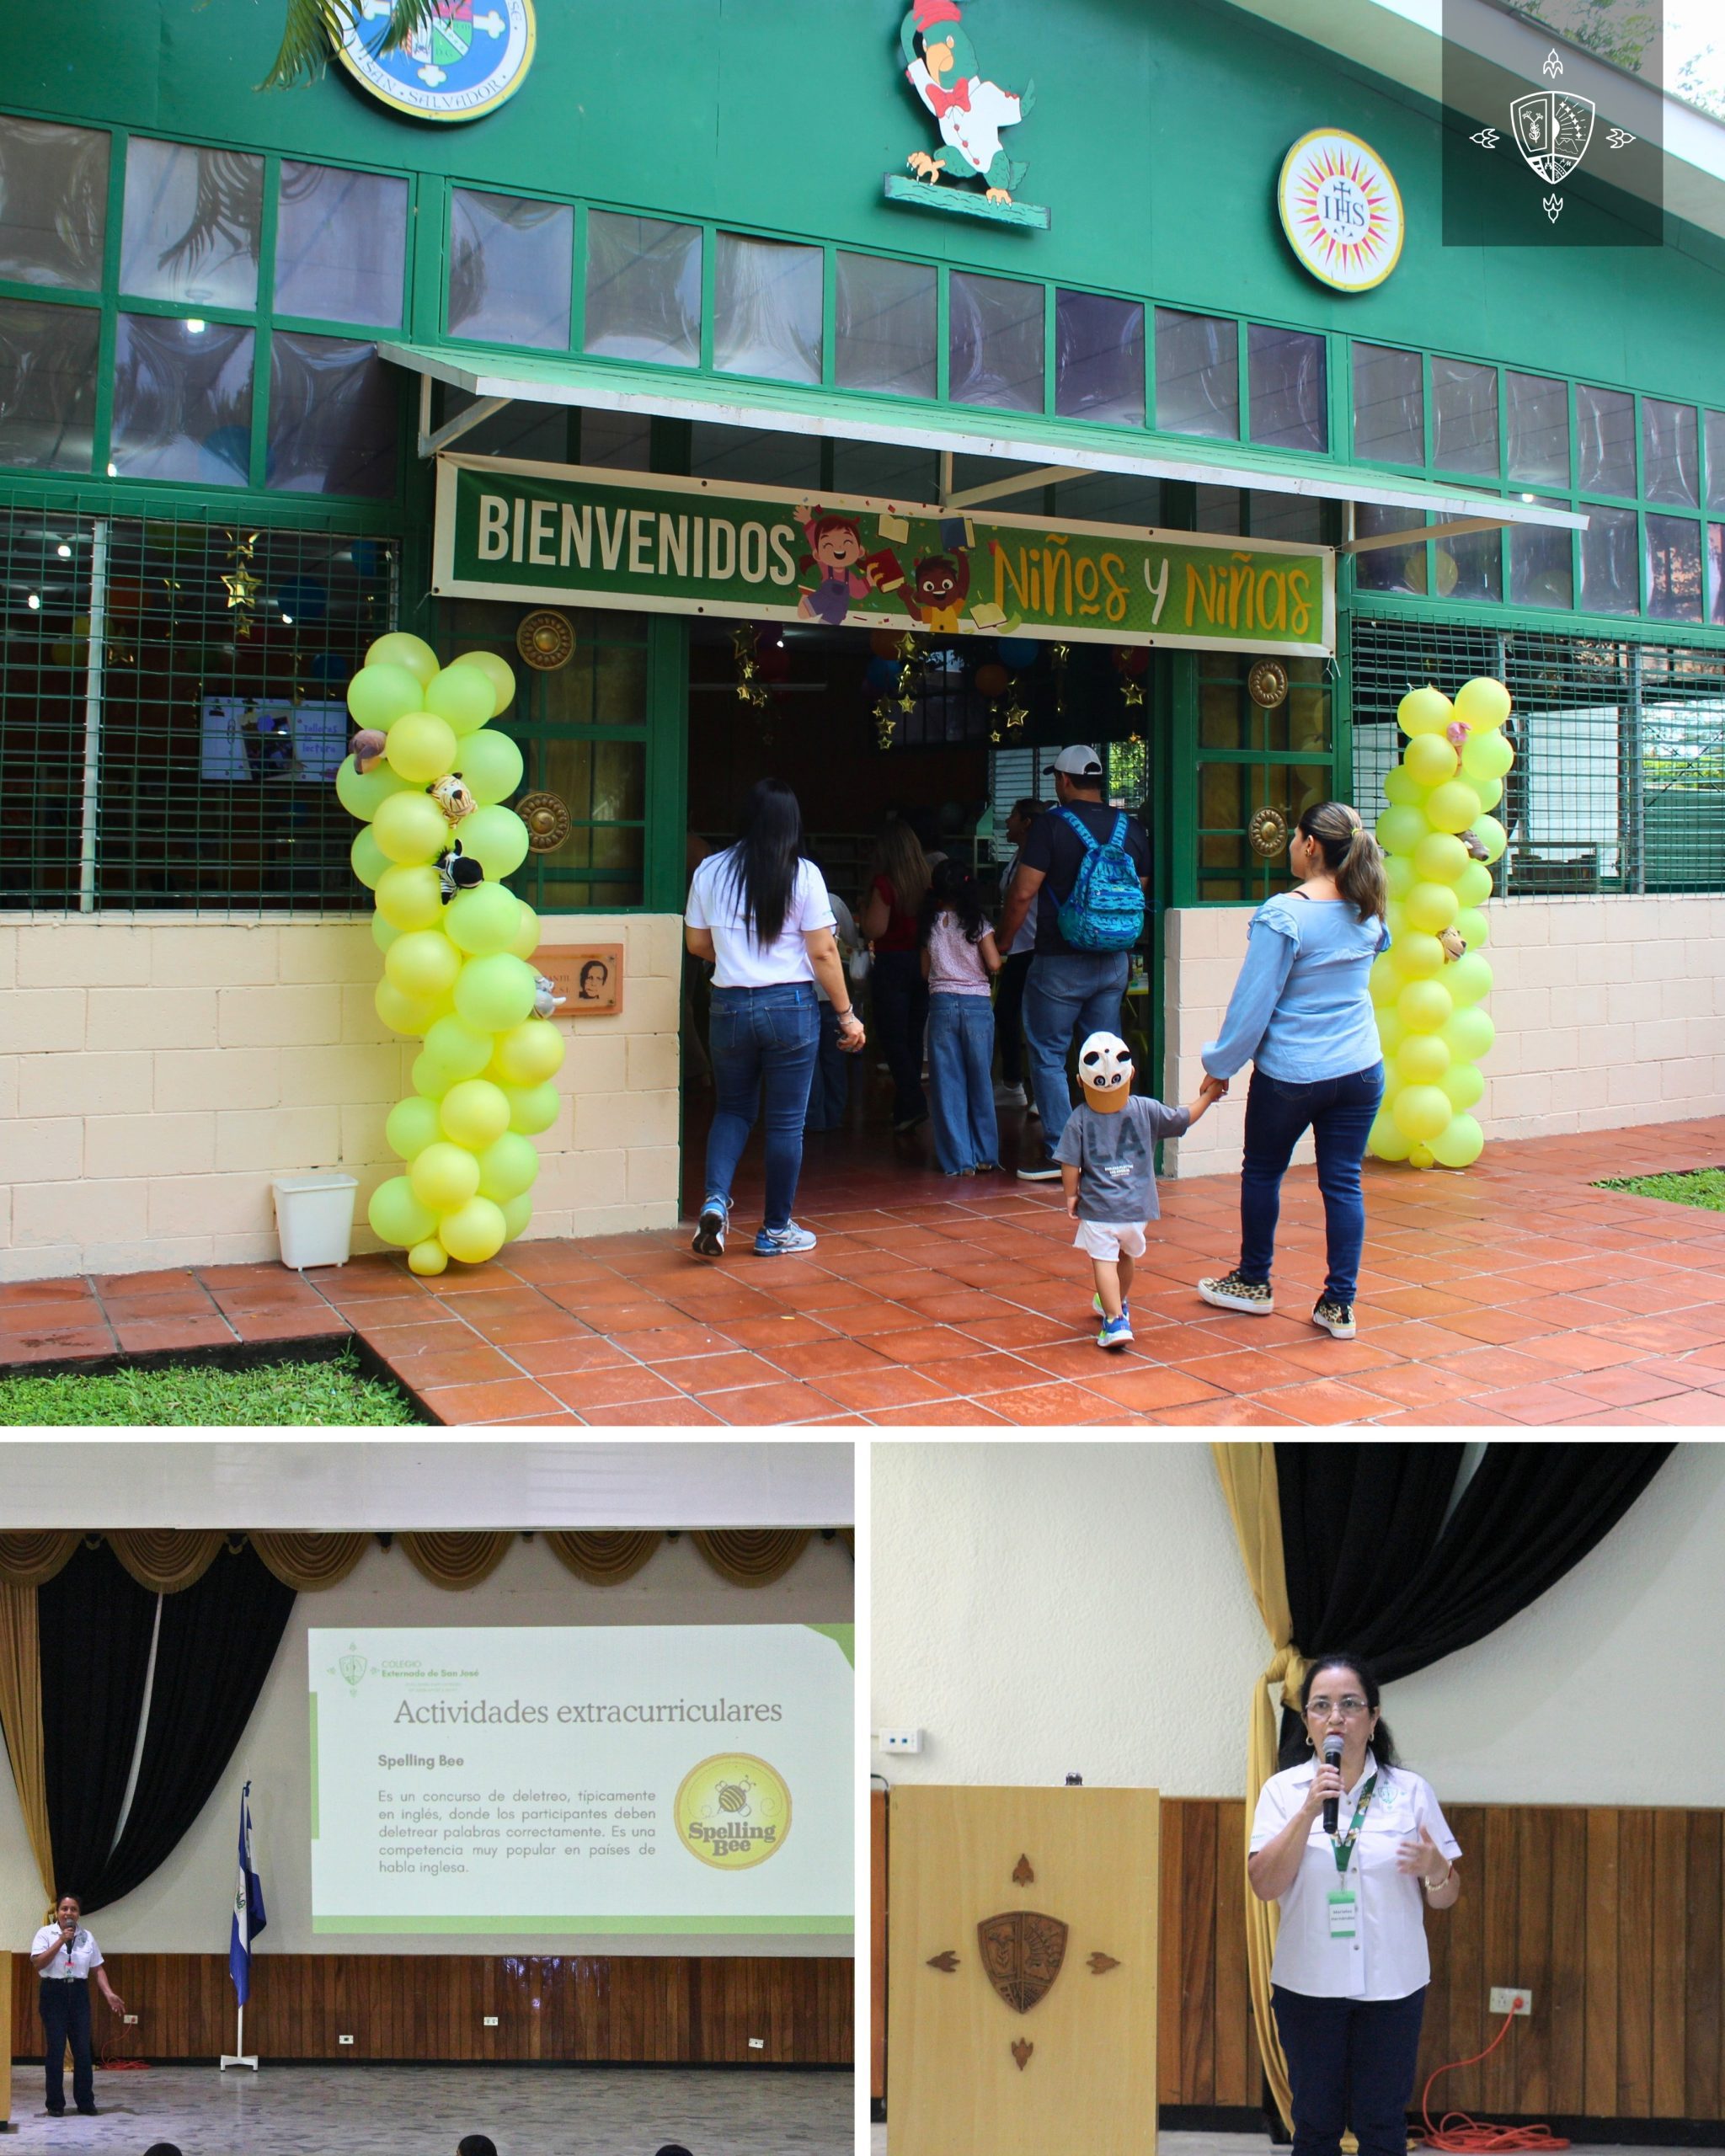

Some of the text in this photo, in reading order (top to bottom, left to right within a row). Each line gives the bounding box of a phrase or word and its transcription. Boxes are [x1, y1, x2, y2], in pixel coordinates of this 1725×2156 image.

[362, 61, 503, 109] SAN SALVADOR
[1322, 192, 1365, 227] IHS
[478, 494, 1313, 636] BIENVENIDOS Niños y Niñas
[1087, 1116, 1146, 1163] LA
[382, 1660, 422, 1668] COLEGIO
[382, 1669, 425, 1678] Externado
[441, 1669, 457, 1678] San
[459, 1668, 479, 1678] José
[393, 1698, 783, 1724] Actividades extracurriculares
[378, 1753, 464, 1769] Spelling Bee
[379, 1790, 393, 1801] Es
[489, 1790, 505, 1801] de
[513, 1789, 571, 1803] deletreo,
[578, 1789, 656, 1805] típicamente
[402, 1807, 441, 1823] inglés,
[449, 1807, 490, 1819] donde
[498, 1807, 515, 1819] los
[521, 1808, 607, 1823] participantes
[614, 1807, 655, 1819] deben
[379, 1826, 438, 1838] deletrear
[444, 1826, 500, 1840] palabras
[506, 1826, 606, 1838] correctamente.
[612, 1826, 626, 1837] Es
[688, 1821, 777, 1844] Spelling
[379, 1844, 463, 1858] competencia
[473, 1847, 498, 1858] muy
[507, 1844, 556, 1859] popular
[590, 1844, 630, 1858] países
[639, 1843, 655, 1854] de
[712, 1839, 751, 1856] Bee
[380, 1860, 468, 1876] habla inglesa.
